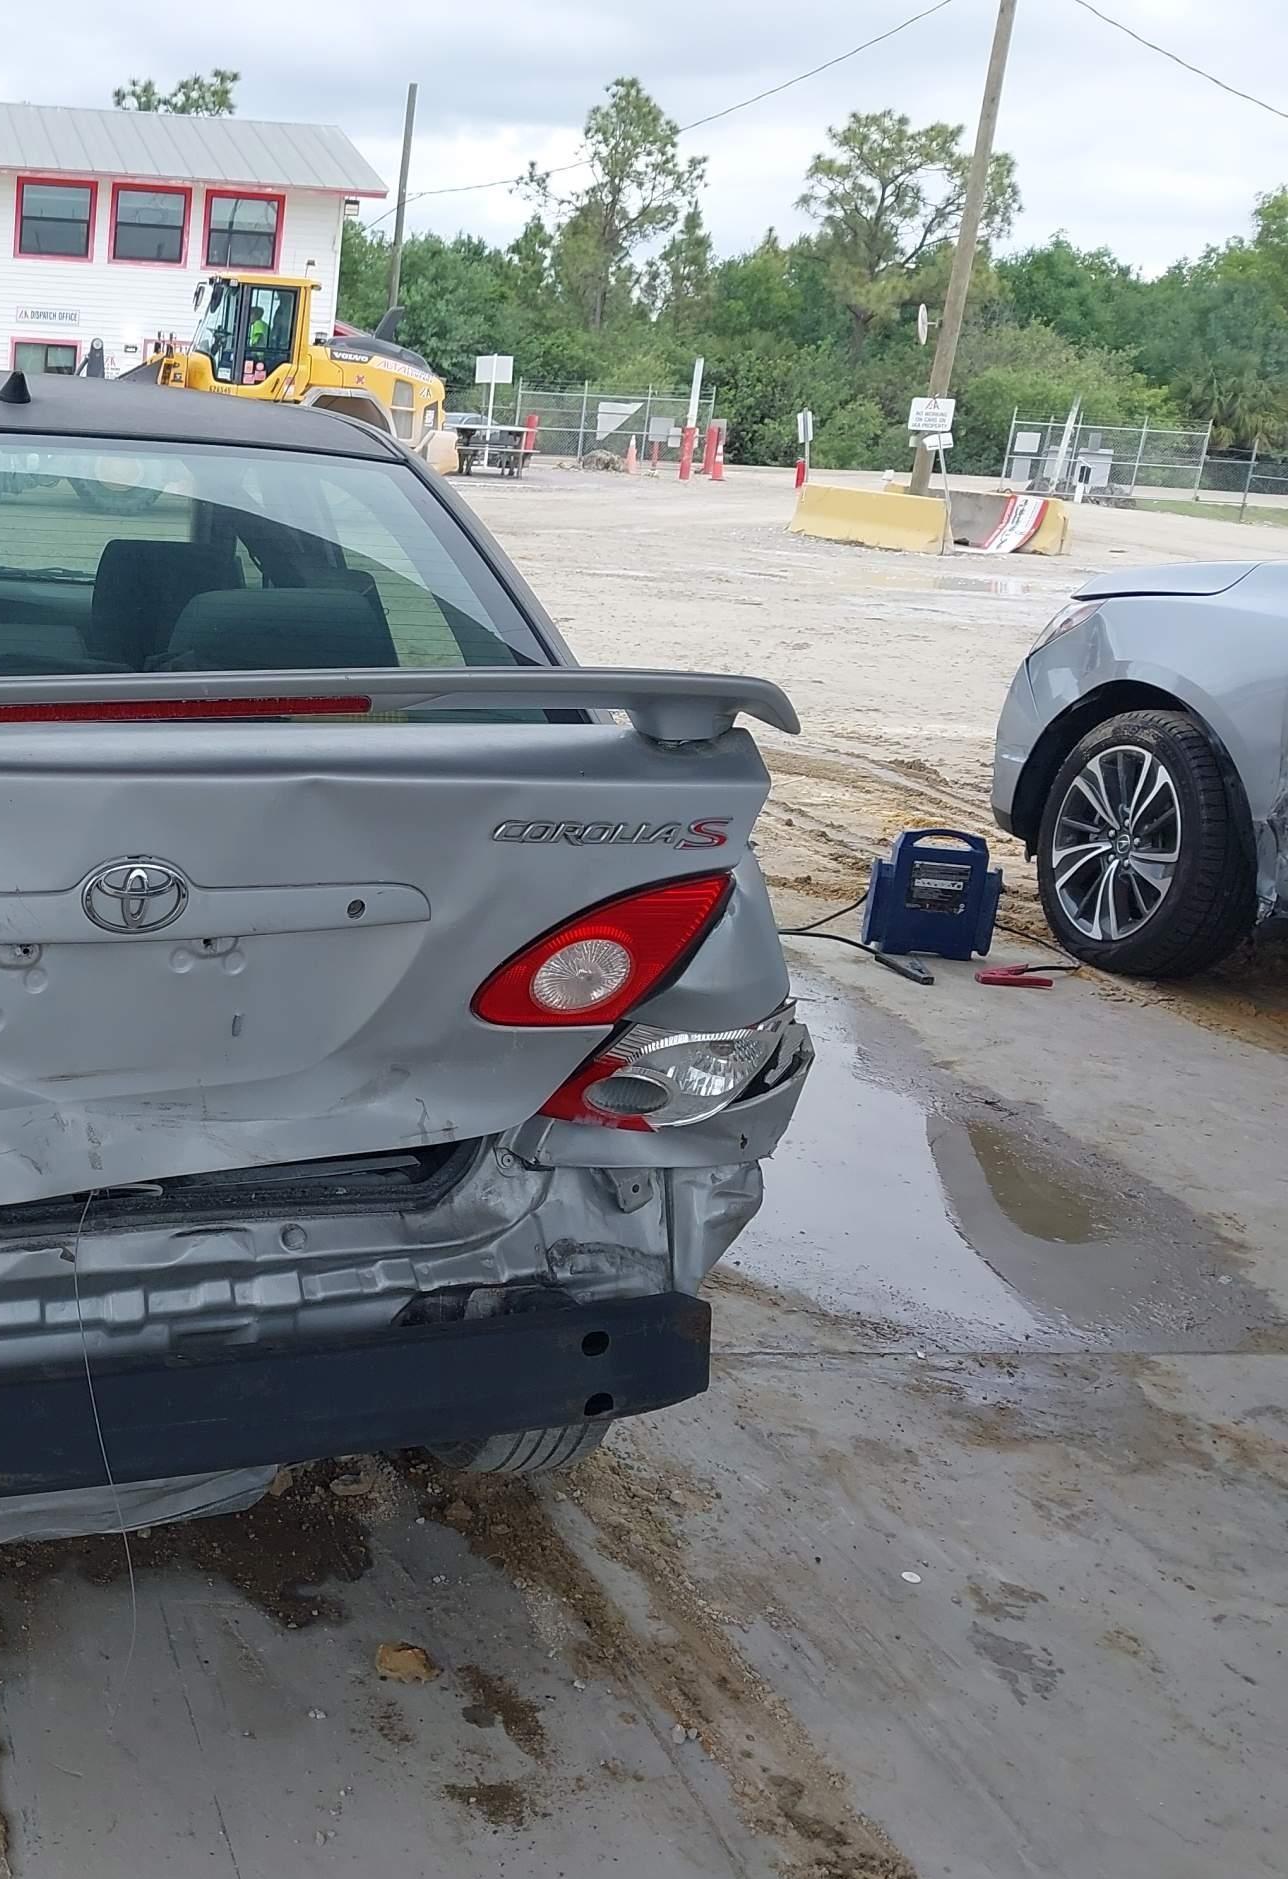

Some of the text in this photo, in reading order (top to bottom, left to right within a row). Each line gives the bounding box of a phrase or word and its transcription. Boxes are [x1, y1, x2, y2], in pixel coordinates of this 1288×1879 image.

[30, 310, 57, 321] DISPATCH
[58, 311, 78, 322] OFFICE
[332, 351, 369, 362] VOLVO
[491, 816, 734, 850] COROLLA S
